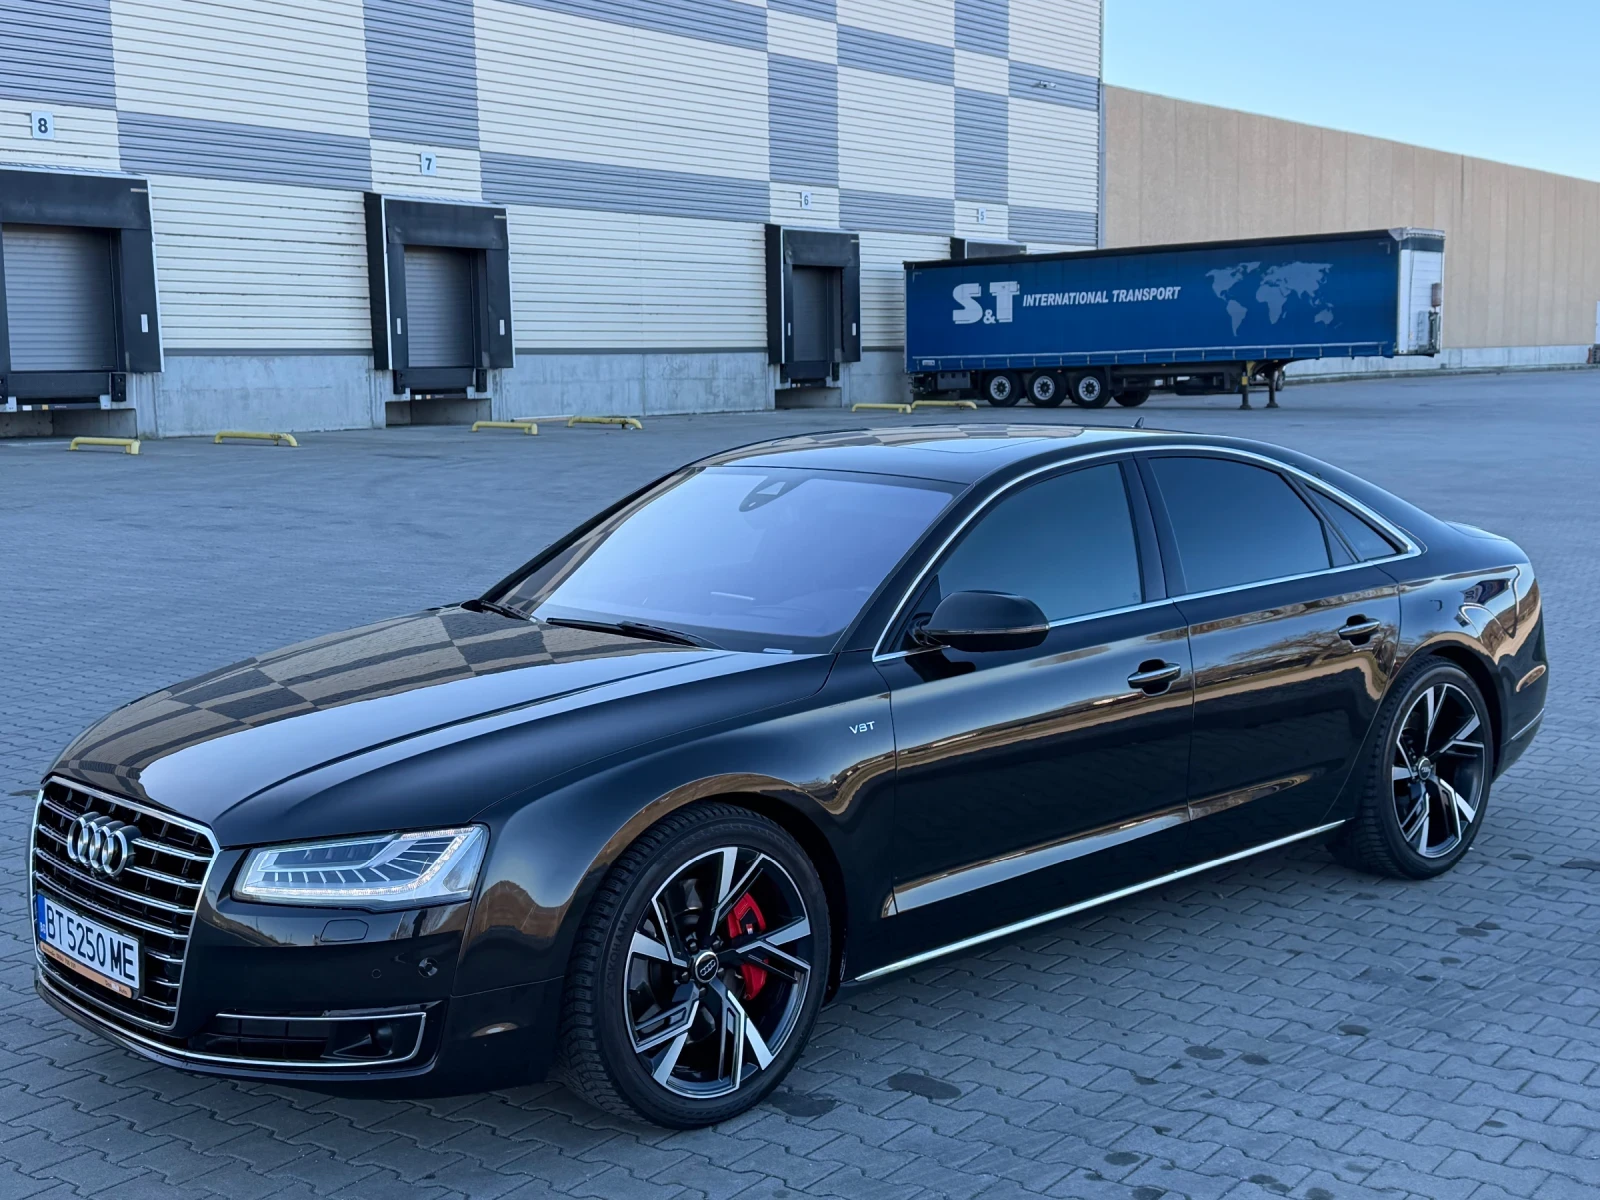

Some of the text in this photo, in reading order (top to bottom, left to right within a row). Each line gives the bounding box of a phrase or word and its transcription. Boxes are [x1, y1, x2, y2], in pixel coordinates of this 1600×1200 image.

[37, 117, 49, 134] 8
[425, 157, 433, 171] 7
[803, 194, 810, 206] 6
[980, 211, 985, 221] 5
[952, 281, 1020, 324] S&T
[1022, 286, 1181, 307] INTERNATIONAL TRANSPORT
[848, 720, 875, 735] V8T
[46, 904, 64, 947] BT
[66, 915, 106, 968] 5250
[109, 936, 136, 982] ME
